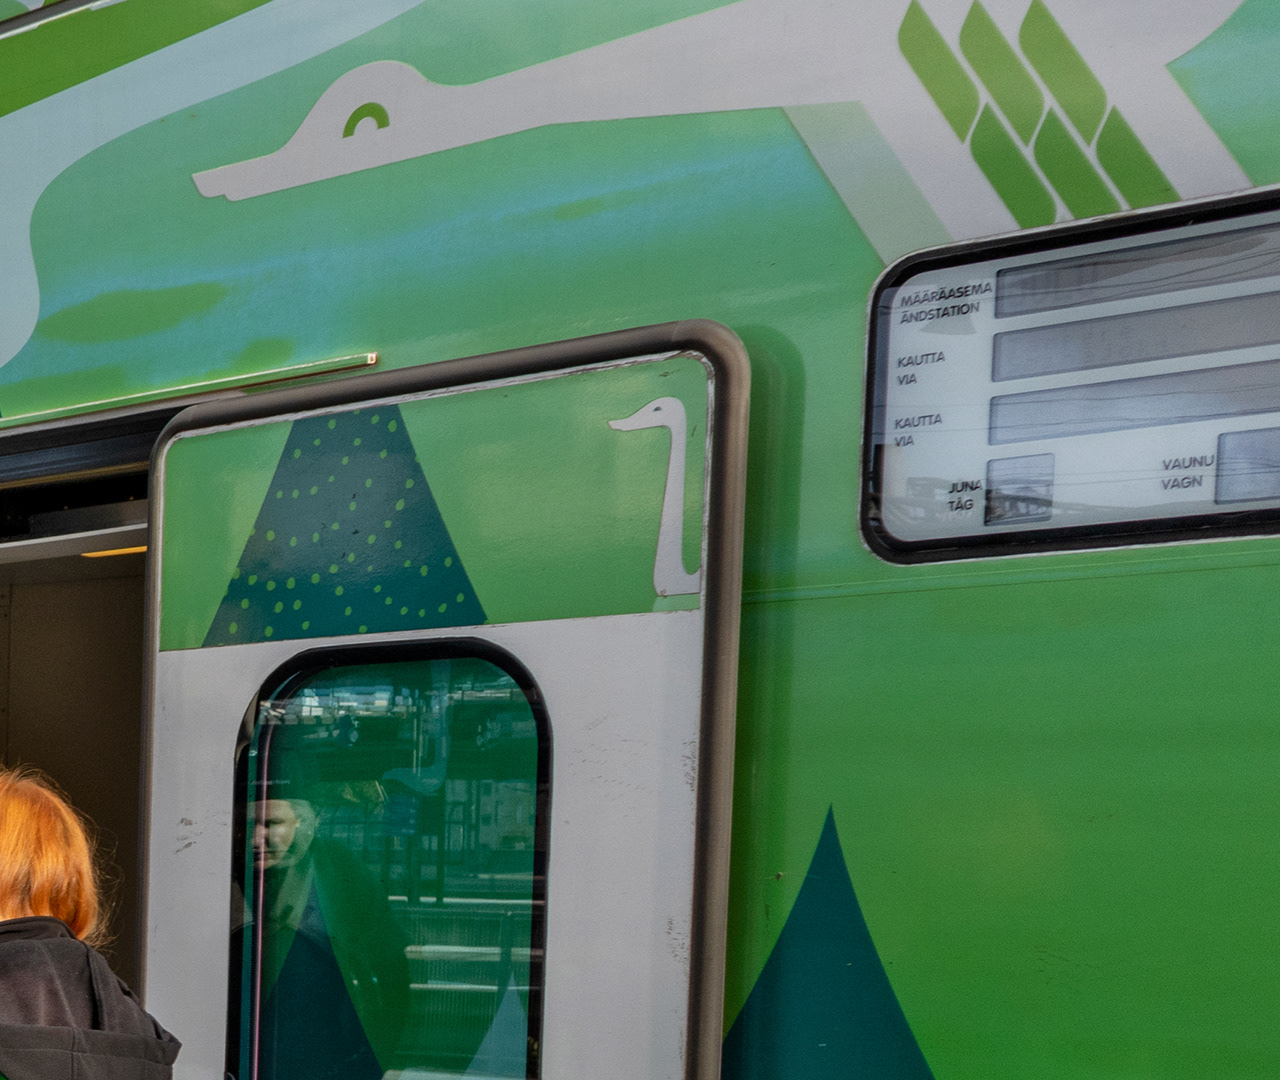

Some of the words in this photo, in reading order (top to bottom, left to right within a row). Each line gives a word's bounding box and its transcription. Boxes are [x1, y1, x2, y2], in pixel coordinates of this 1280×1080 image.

[901, 283, 992, 307] MÄÄRÄASEMA
[900, 302, 980, 324] ÄNDSTATION
[897, 352, 945, 368] KAUTTA
[897, 374, 917, 385] VIA
[894, 414, 942, 429] KAUTTA
[894, 435, 914, 447] VIA
[1162, 455, 1215, 471] VAUNU
[948, 480, 983, 494] JUNA
[1161, 475, 1203, 490] VAGN
[948, 497, 975, 512] TÅG
